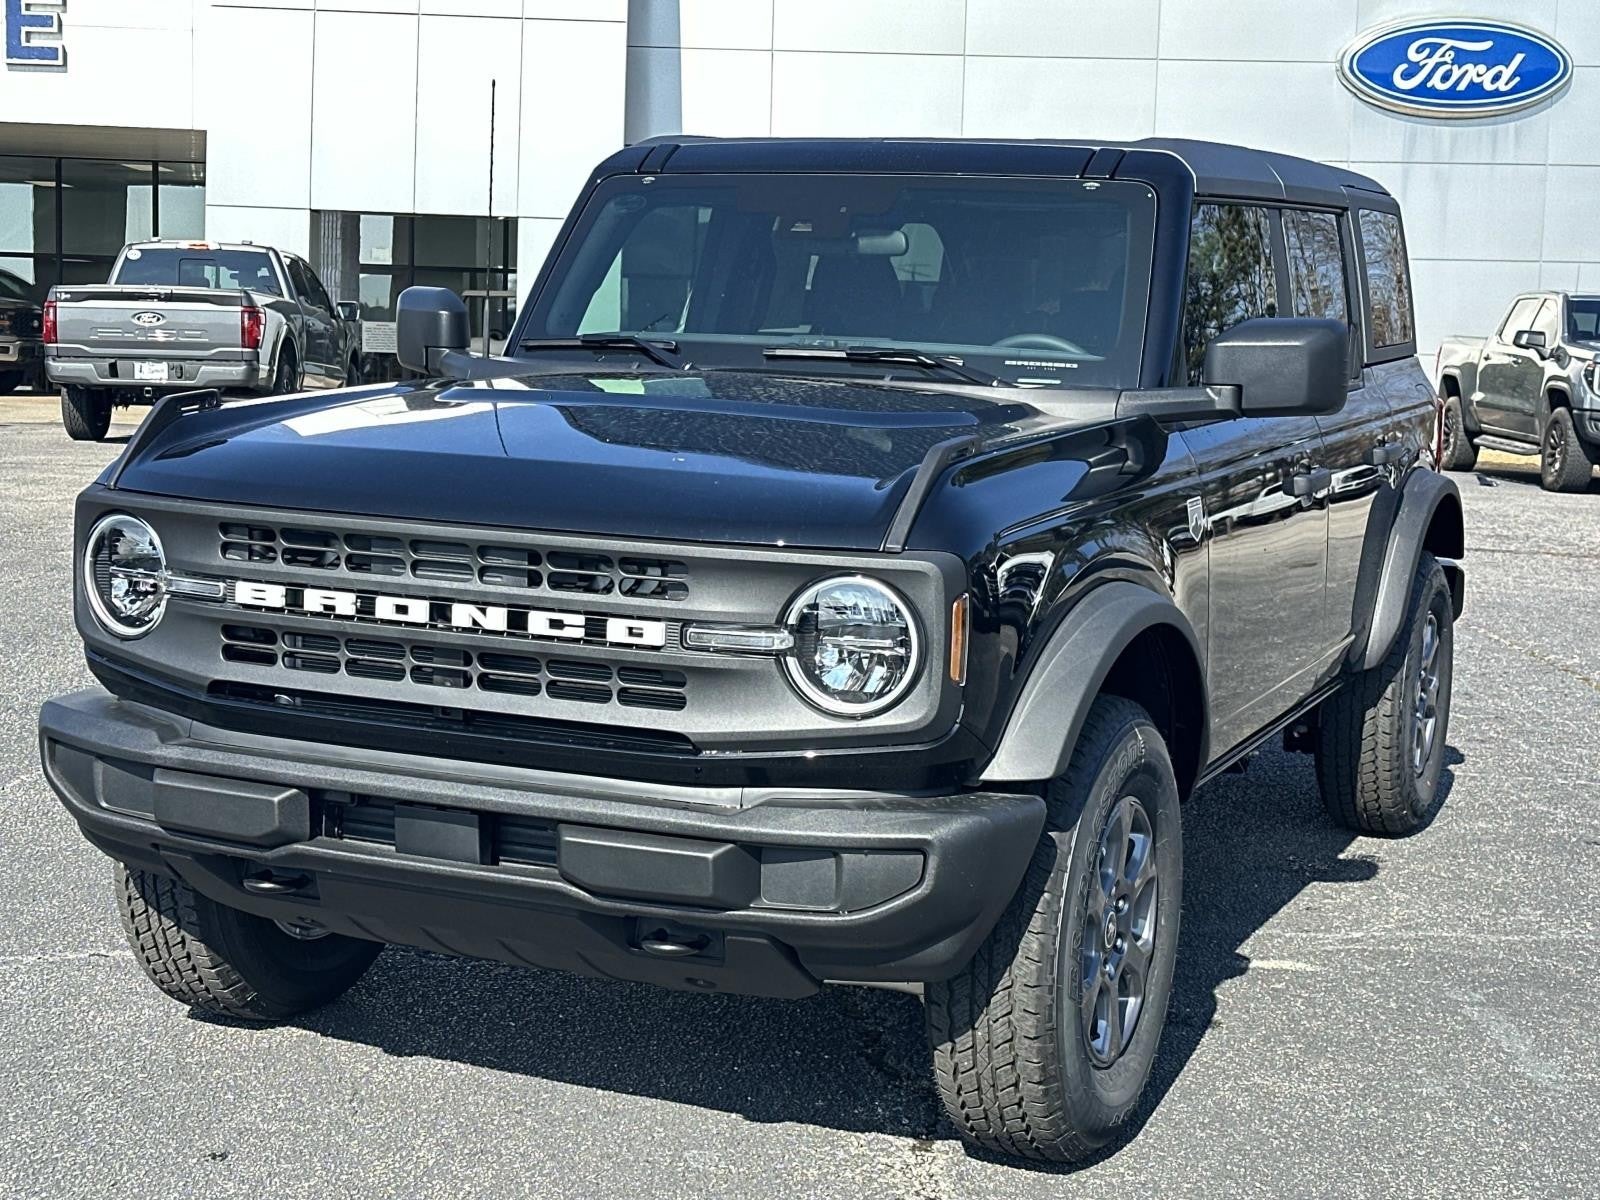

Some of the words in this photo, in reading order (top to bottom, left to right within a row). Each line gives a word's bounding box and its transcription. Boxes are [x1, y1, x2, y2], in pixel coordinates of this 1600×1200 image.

[5, 0, 64, 66] E
[1392, 37, 1526, 92] Ford
[234, 580, 667, 648] BRONCO
